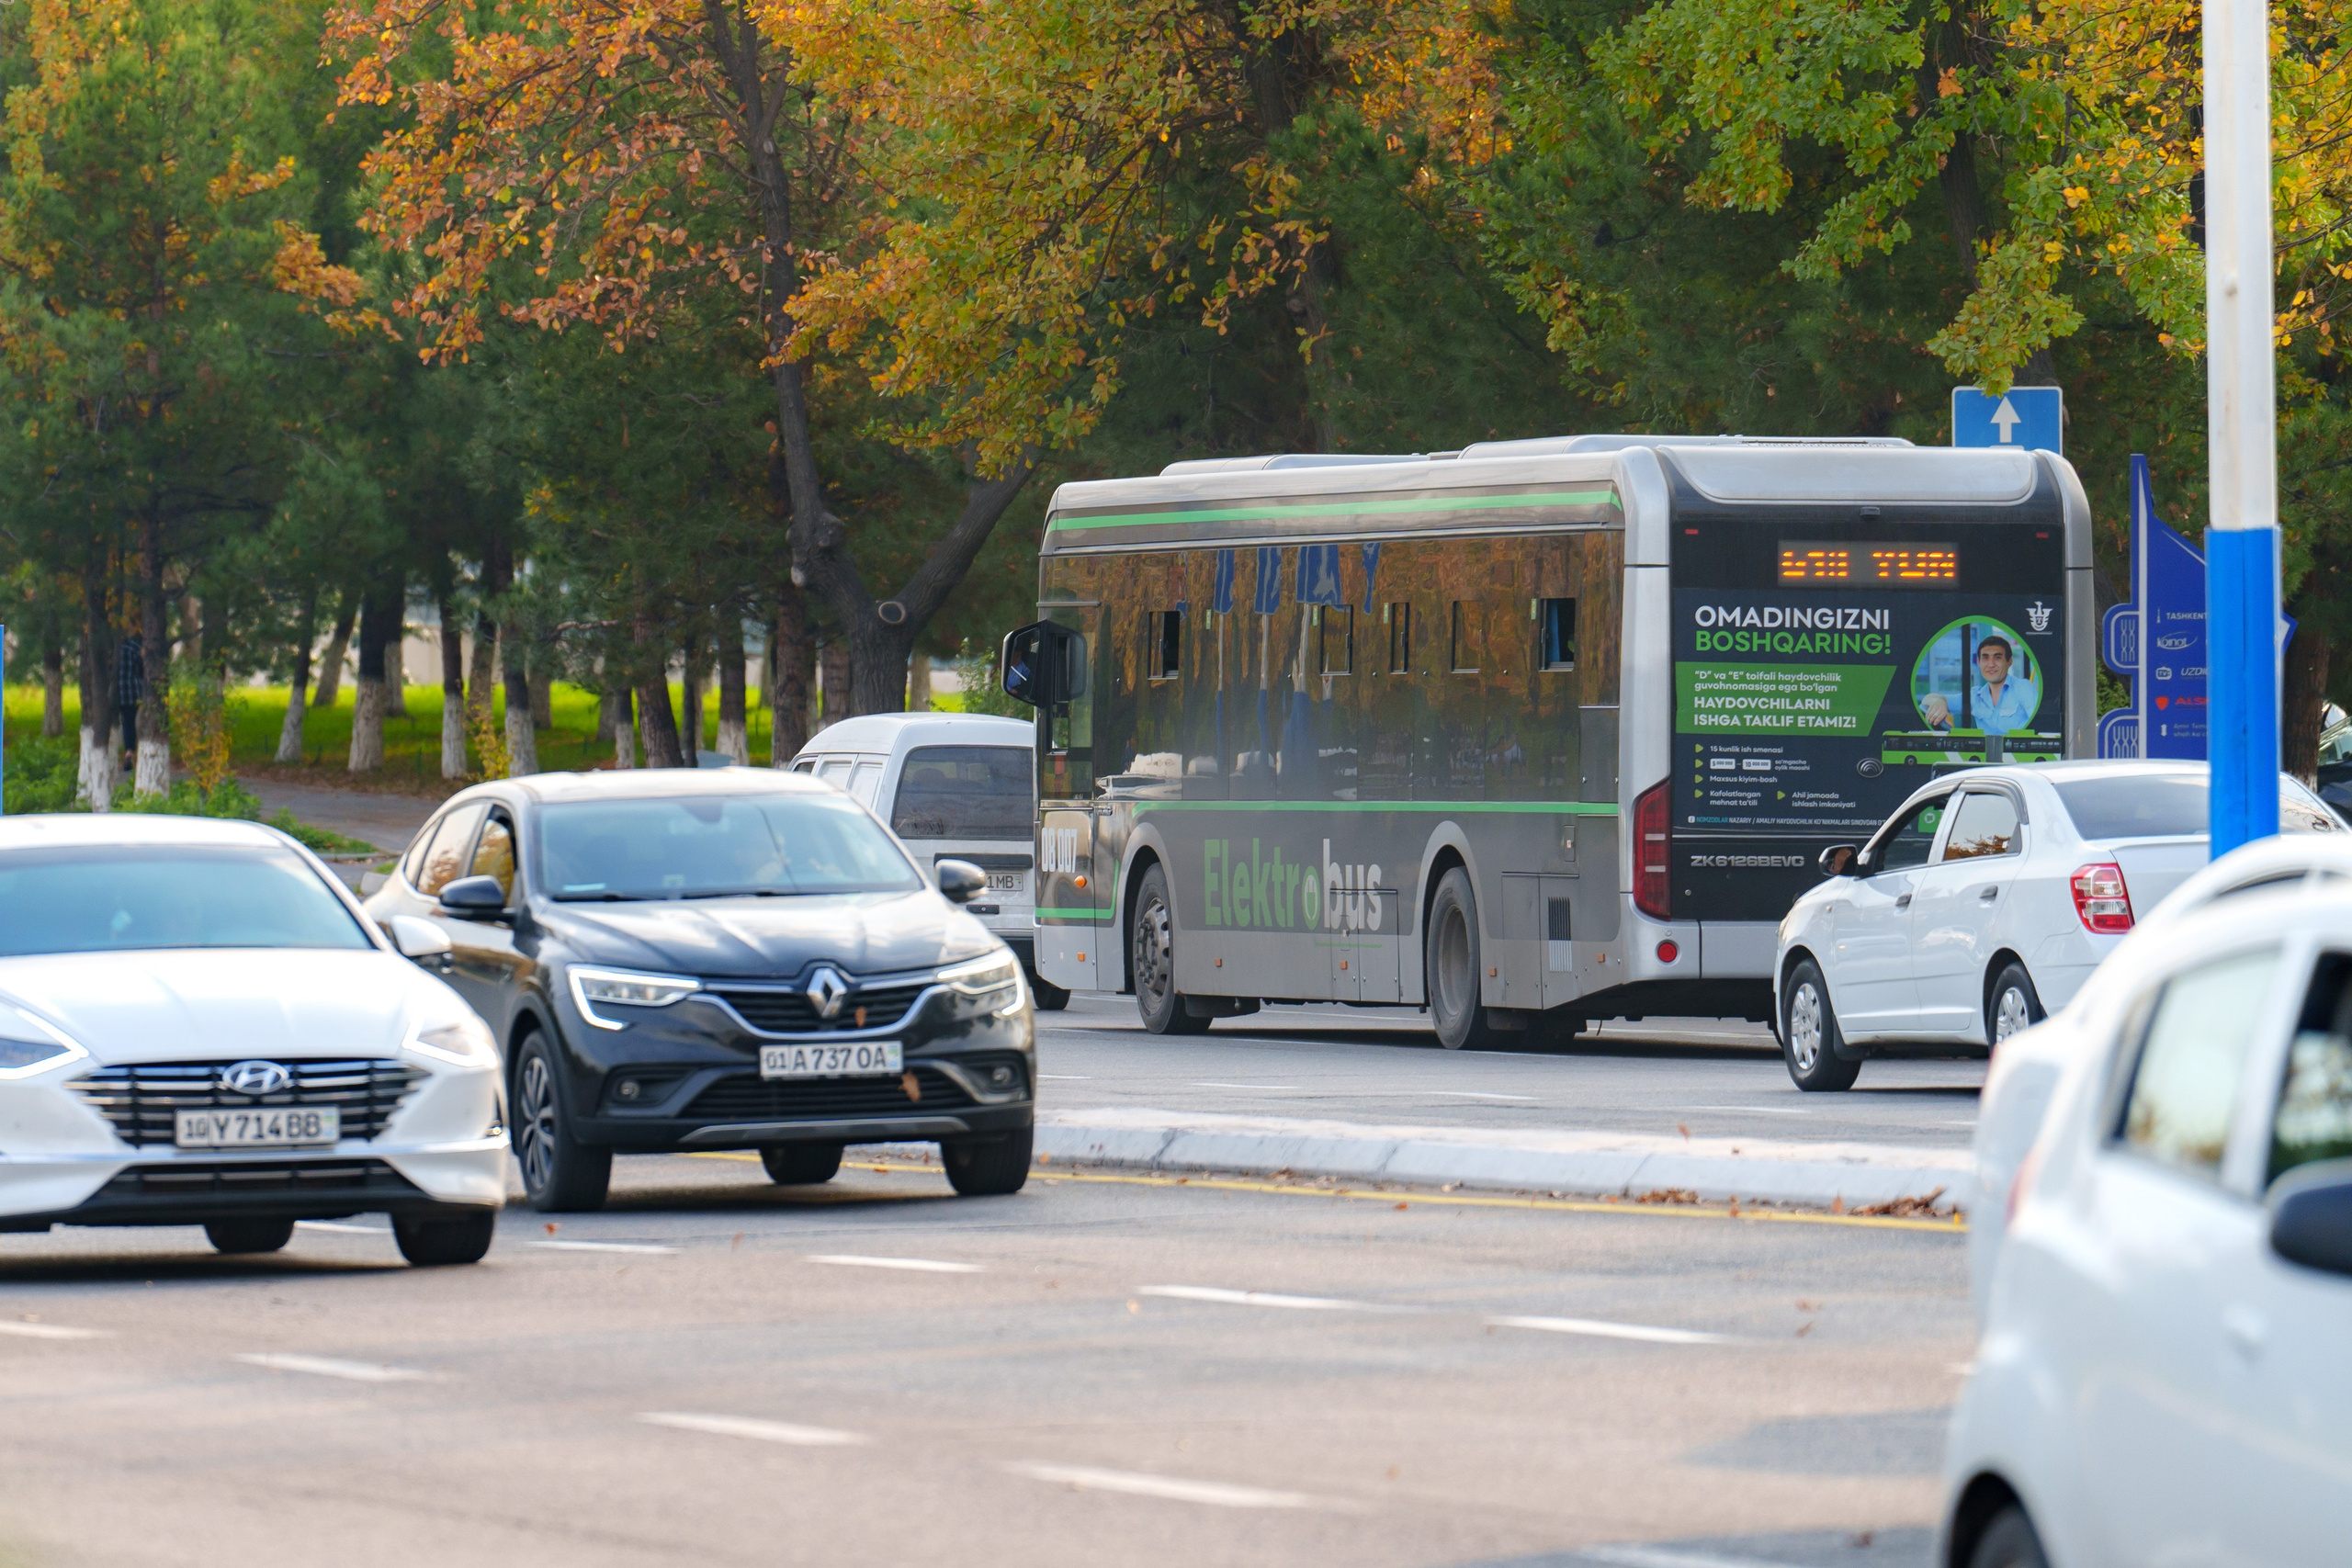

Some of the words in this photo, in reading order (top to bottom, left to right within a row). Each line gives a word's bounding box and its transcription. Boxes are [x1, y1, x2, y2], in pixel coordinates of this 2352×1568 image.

[1694, 605, 1889, 629] OMADINGIZNI
[2165, 612, 2208, 620] TASHKENT
[1695, 630, 1891, 655] BOSHQARING!
[1746, 671, 1776, 681] toifali
[1778, 671, 1841, 682] haydovchilik
[1694, 681, 1776, 693] guvohnomasiga
[1778, 683, 1798, 694] ega
[1694, 697, 1830, 710] HAYDOVCHILARNI
[1694, 714, 1741, 727] ISHGA
[1744, 715, 1794, 727] TAKLIF
[1797, 716, 1857, 728] ETAMIZ!
[1690, 855, 1805, 868] ZK6126BEVG
[987, 875, 1014, 889] 1MB
[1204, 837, 1382, 931] Elektrobus
